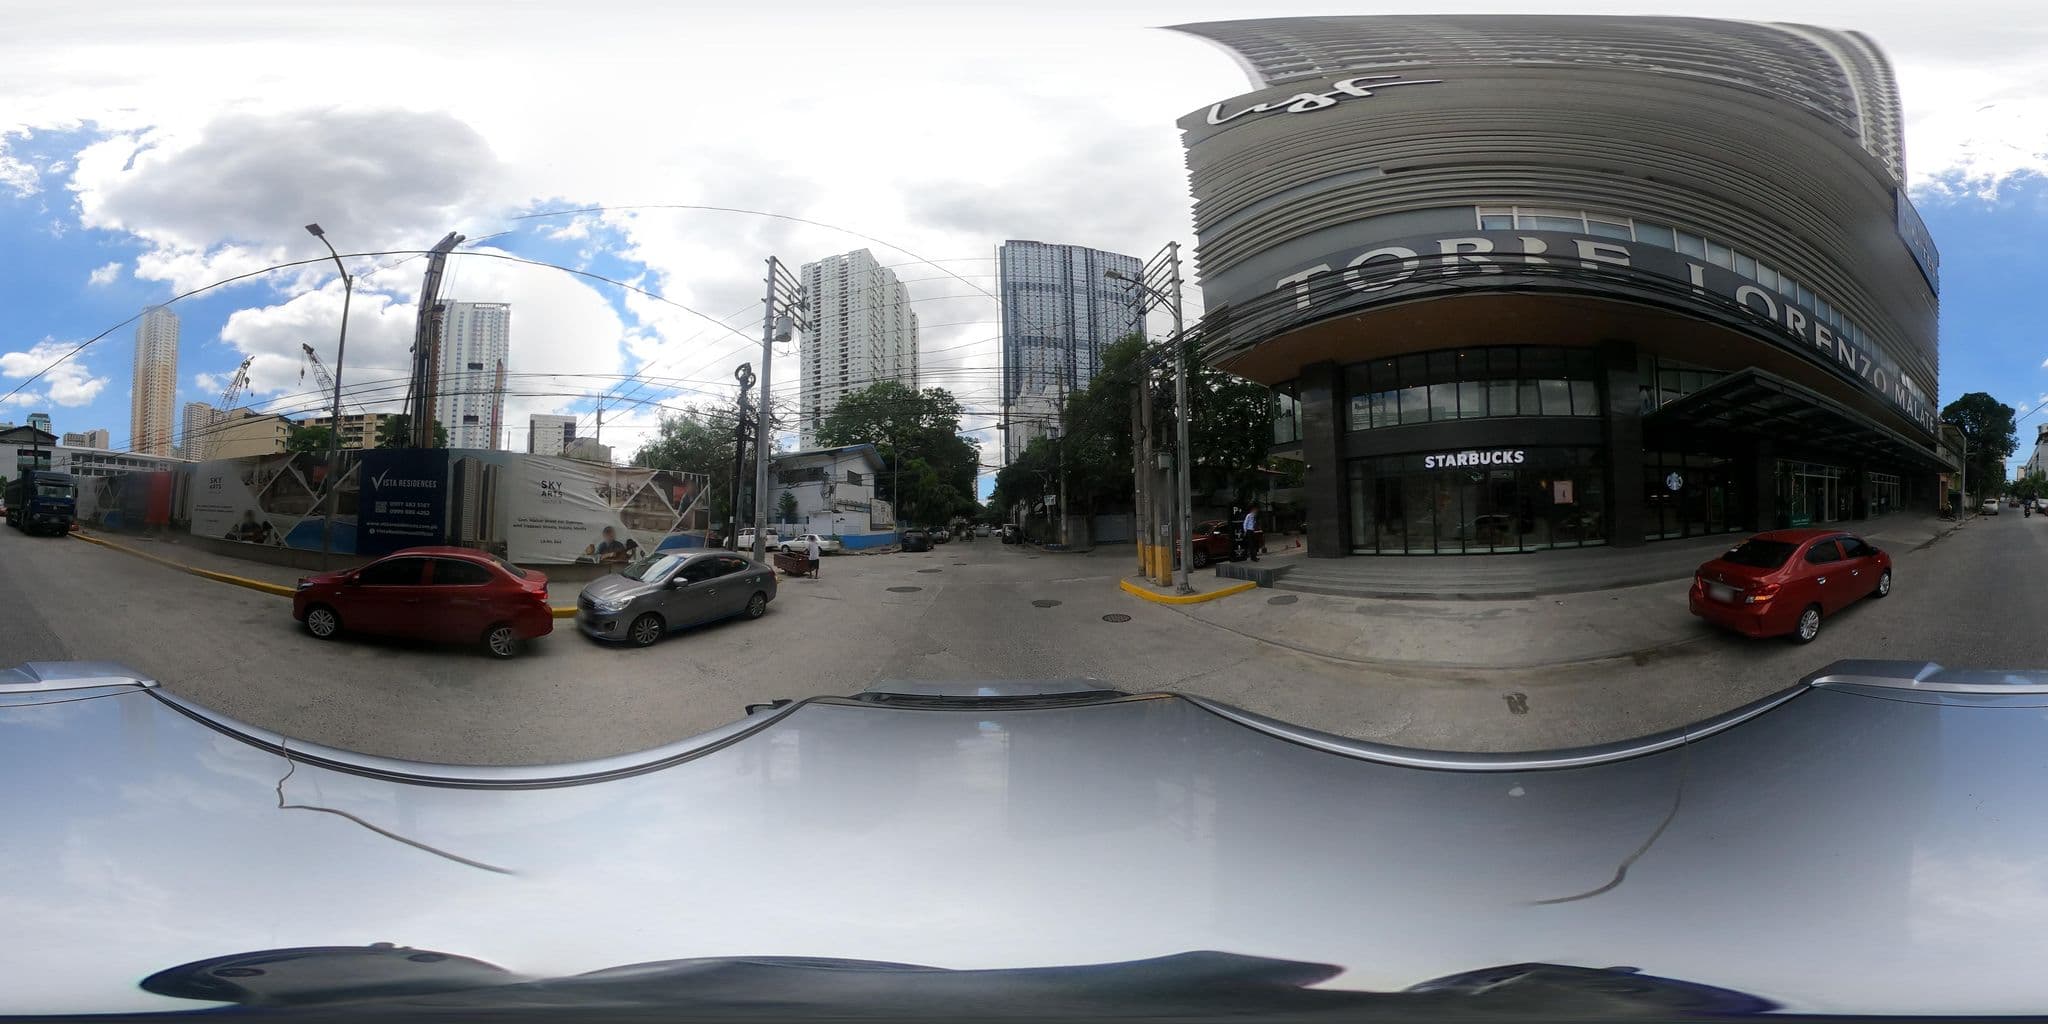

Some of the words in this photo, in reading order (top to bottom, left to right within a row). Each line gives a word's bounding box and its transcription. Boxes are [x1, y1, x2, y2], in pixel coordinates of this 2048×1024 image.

[1895, 384, 1935, 434] MALATE
[1425, 451, 1525, 468] STARBUCKS
[399, 480, 438, 488] RESIDENCES
[541, 480, 562, 490] SKY
